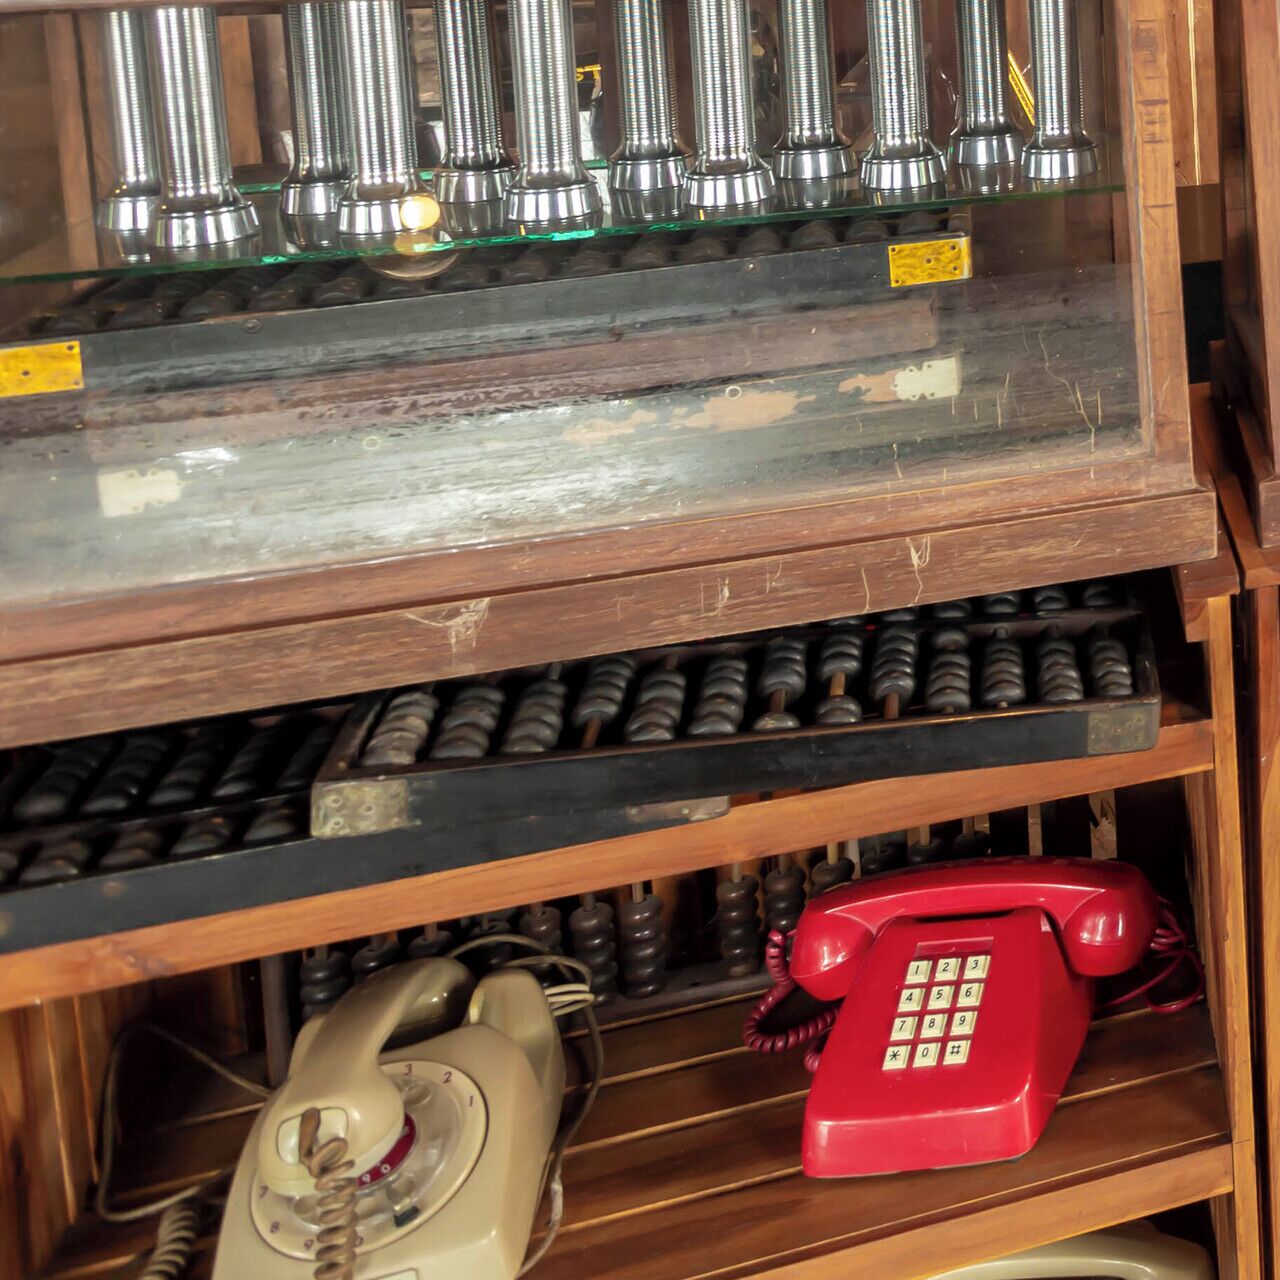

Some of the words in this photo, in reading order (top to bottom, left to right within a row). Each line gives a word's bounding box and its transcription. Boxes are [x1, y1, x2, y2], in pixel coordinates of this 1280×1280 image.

[942, 962, 950, 972] 2
[972, 959, 979, 969] 3
[906, 992, 913, 1002] 4
[936, 989, 943, 1000] 5
[965, 987, 973, 997] 6
[899, 1020, 906, 1031] 7
[928, 1018, 936, 1028] 8
[958, 1015, 966, 1025] 9
[921, 1047, 929, 1057] 0
[403, 1064, 413, 1076] 3
[443, 1071, 452, 1083] 2
